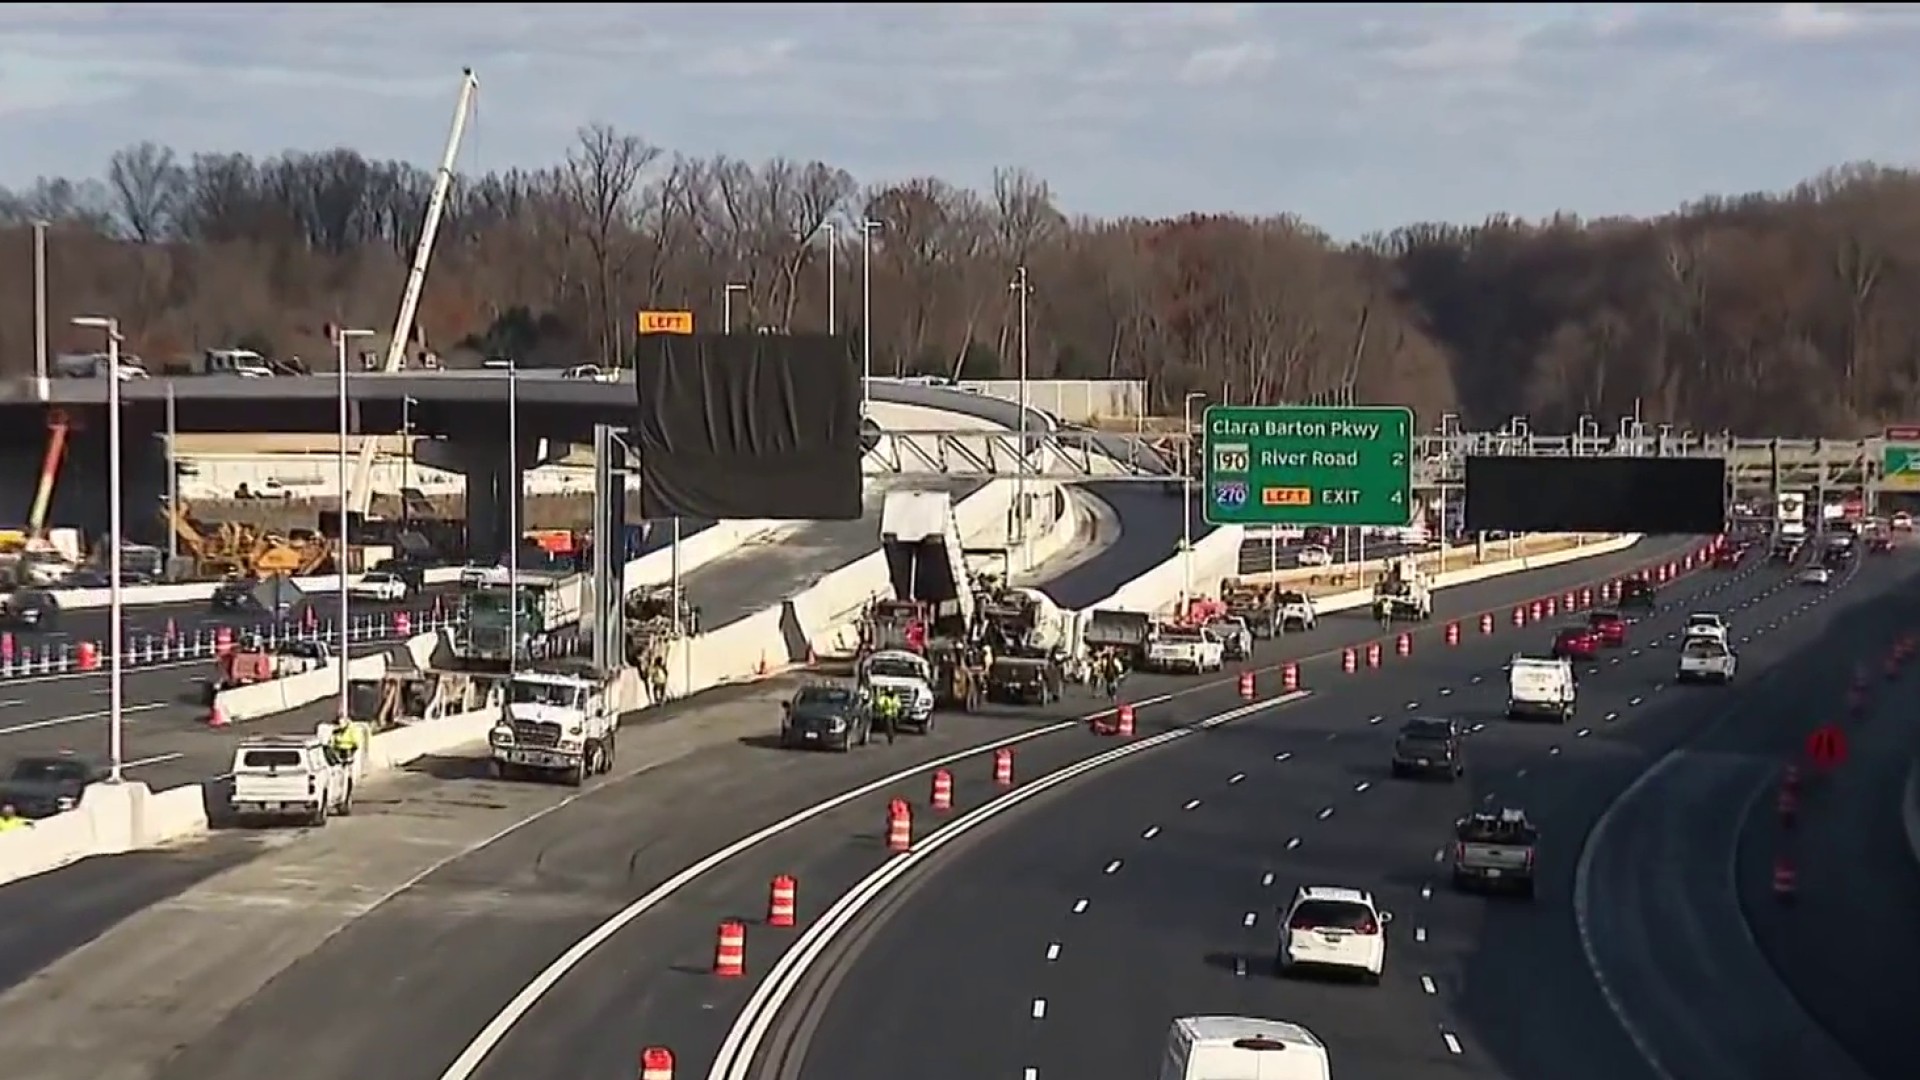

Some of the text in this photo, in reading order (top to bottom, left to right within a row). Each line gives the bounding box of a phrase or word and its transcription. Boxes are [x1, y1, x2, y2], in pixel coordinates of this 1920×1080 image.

[648, 316, 683, 328] LEFT
[1213, 419, 1405, 440] Clara Barton Pkwy 1
[1216, 452, 1246, 470] 190
[1261, 448, 1404, 467] River Road 2
[1217, 488, 1246, 503] 270
[1266, 489, 1402, 504] LEFT EXIT 4
